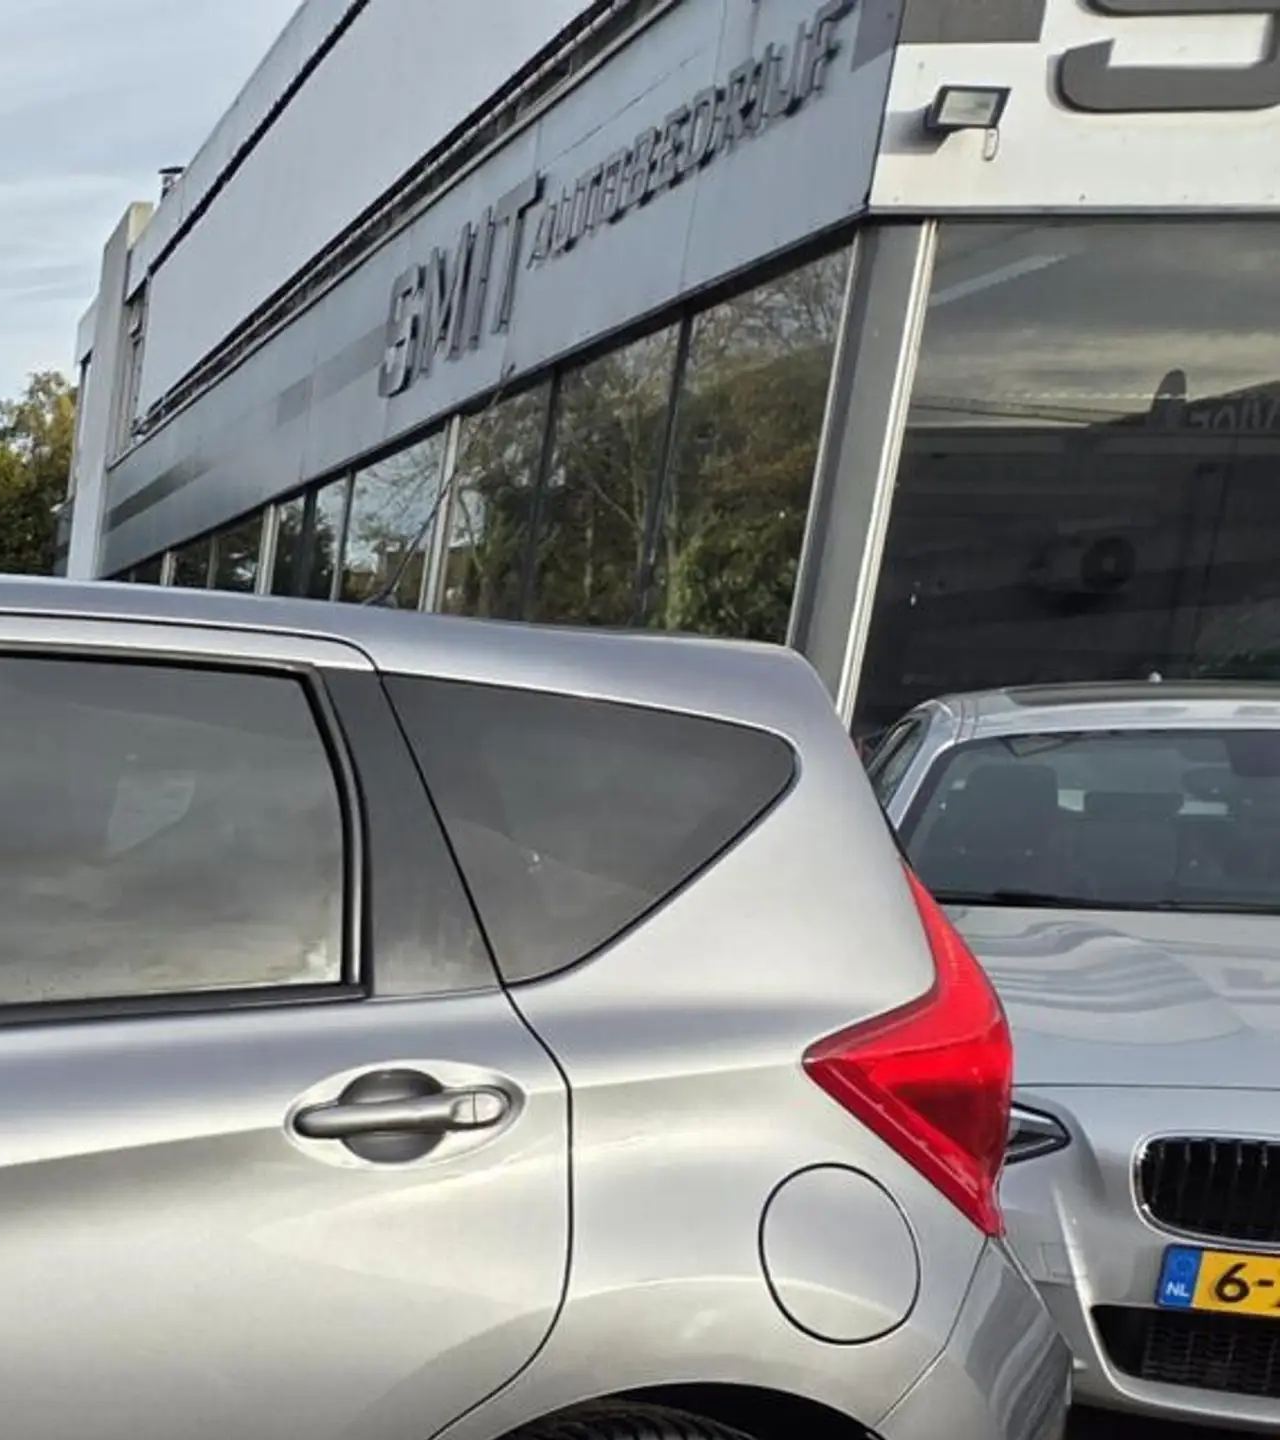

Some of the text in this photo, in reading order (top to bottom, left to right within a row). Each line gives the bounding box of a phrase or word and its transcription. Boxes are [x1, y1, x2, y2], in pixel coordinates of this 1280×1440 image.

[378, 172, 546, 398] SMIT
[526, 0, 852, 270] AUTOBEDRIJF
[1165, 1261, 1280, 1308] NL 6-
